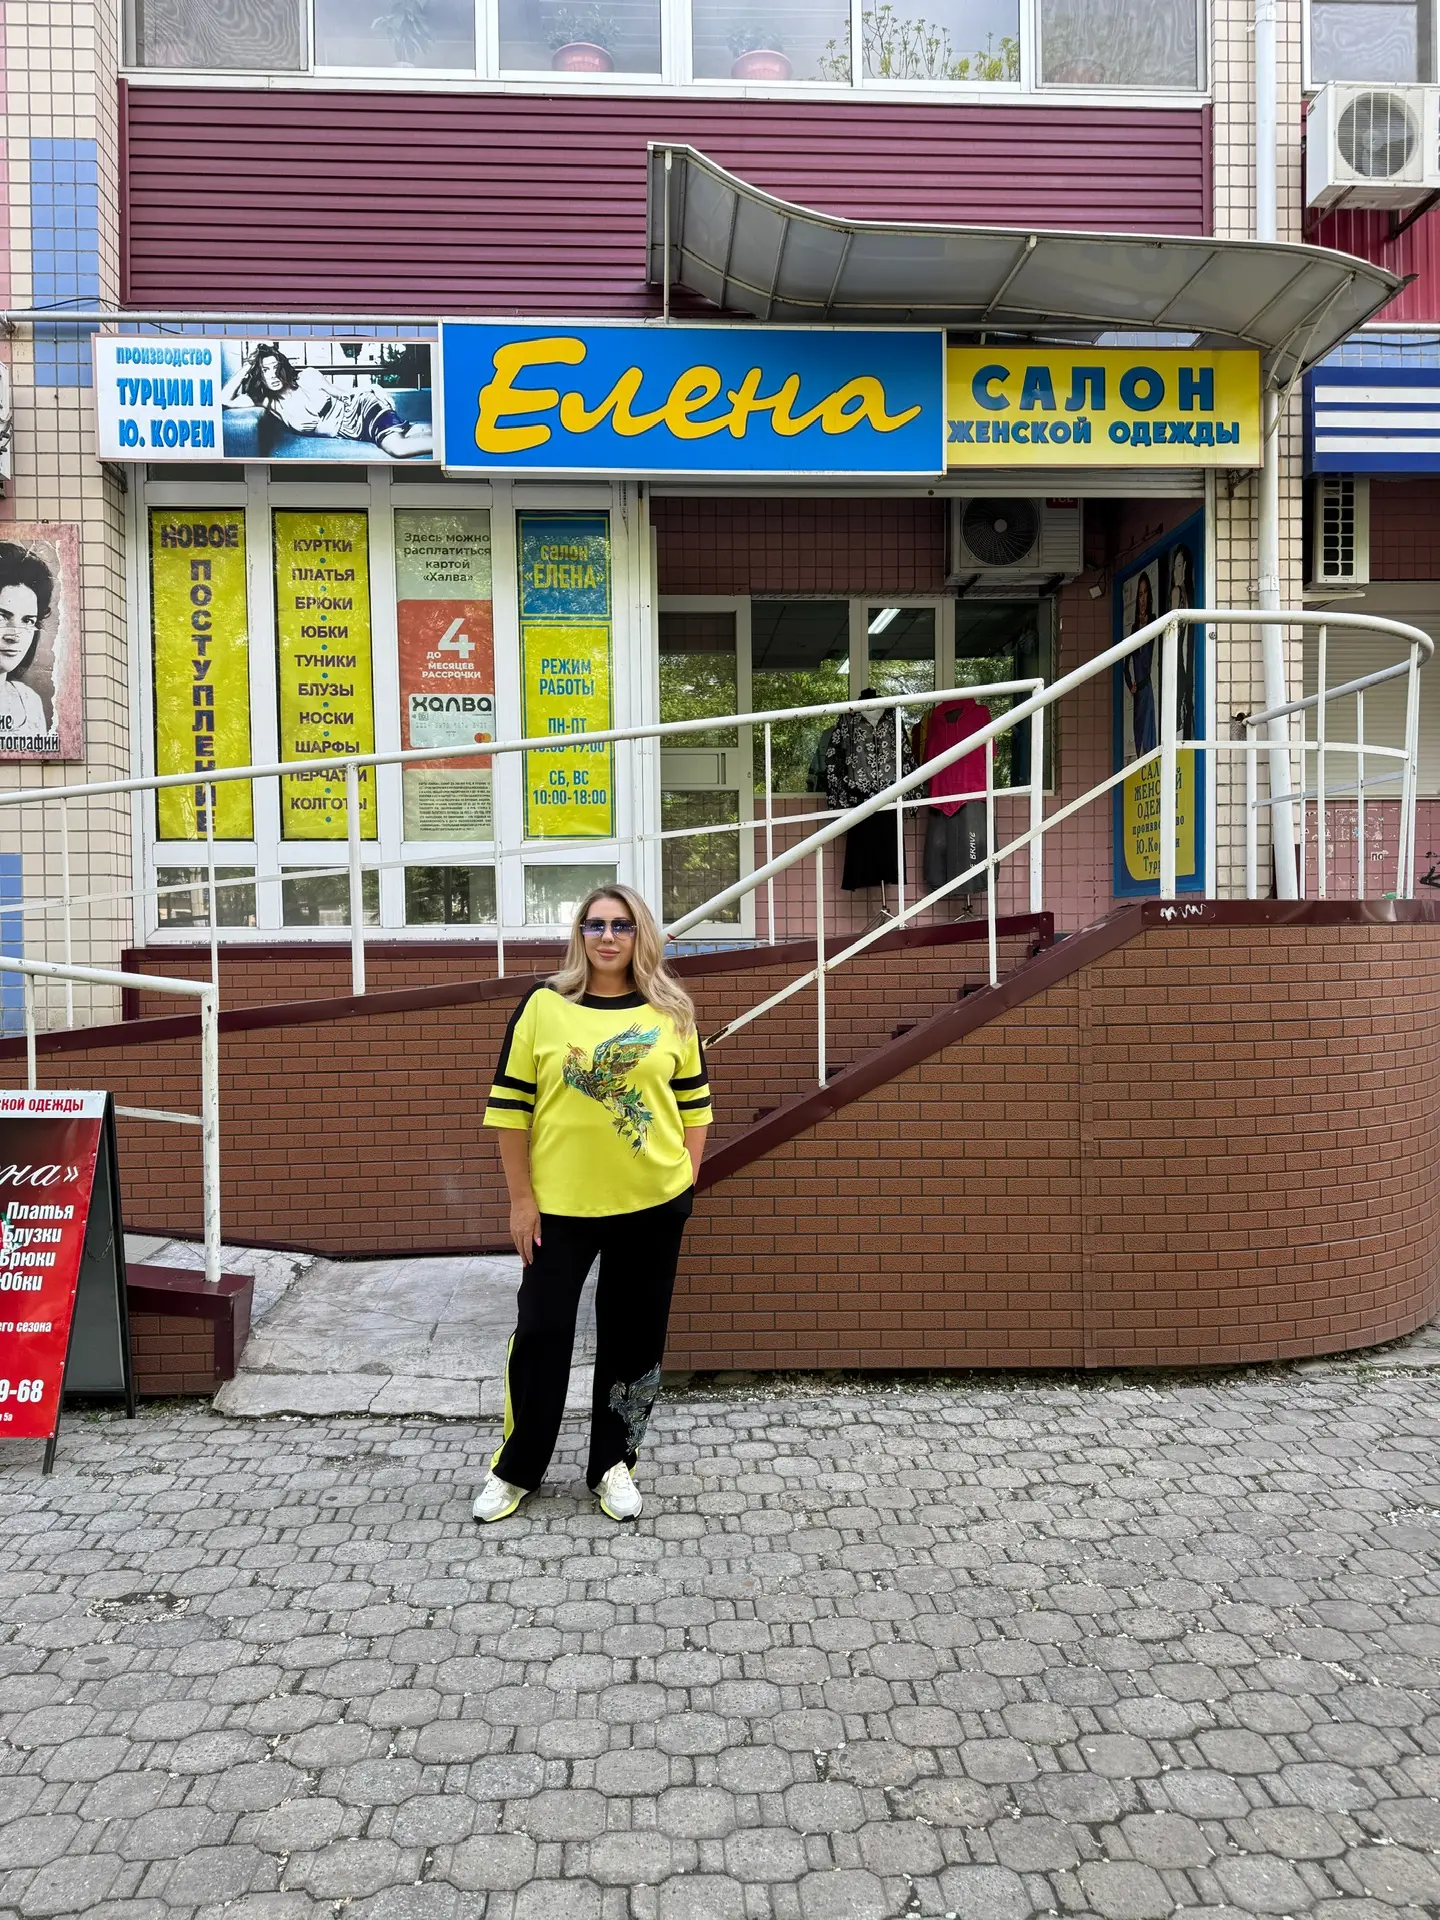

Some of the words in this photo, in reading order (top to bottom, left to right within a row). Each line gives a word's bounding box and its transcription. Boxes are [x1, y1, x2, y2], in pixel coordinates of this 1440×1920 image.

[116, 347, 212, 367] ПРОИЗВОДСТВО
[116, 377, 194, 410] ТУРЦИИ
[200, 378, 213, 406] И
[474, 336, 922, 454] Елена
[971, 364, 1214, 411] САЛОН
[118, 419, 146, 447] Ю.
[151, 419, 215, 448] КОРЕИ
[947, 417, 1091, 443] ЖЕНСКОЙ
[1108, 420, 1239, 447] ОДЕЖДЫ
[161, 523, 239, 548] НОВОЕ
[404, 533, 442, 543] Здесь
[446, 533, 490, 543] можно
[293, 539, 353, 553] КУРТКИ
[404, 547, 491, 557] расплатиться
[540, 545, 588, 561] салон
[425, 560, 470, 570] картой
[292, 568, 355, 581] ПЛАТЬЯ
[423, 572, 473, 582] «Халва»
[523, 564, 605, 589] «ЕЛЕНА»
[295, 596, 353, 610] БРЮКИ
[301, 625, 348, 638] ЮБКИ
[437, 617, 475, 659] 4
[294, 655, 356, 667] ТУНИКИ
[428, 662, 474, 671] МЕСЯЦЕВ
[541, 658, 592, 675] РЕЖИМ
[422, 671, 481, 679] РАССРОЧКИ
[298, 683, 354, 696] БЛУЗЫ
[539, 678, 594, 695] РАБОТЫ
[299, 711, 354, 724] НОСКИ
[548, 717, 587, 733] ПН-ПТ
[295, 740, 360, 753] ШАРФЫ
[289, 768, 367, 782] ПЕРЧАТИ
[549, 770, 569, 787] СБ,
[573, 770, 589, 785] ВС
[1141, 761, 1160, 781] САЛ
[1134, 767, 1182, 801] ЖЕНСЙ
[533, 789, 607, 805] 10:00-18:00
[0, 1097, 25, 1111] КОЙ
[28, 1098, 84, 1113] ОДЕЖДЫ
[7, 1201, 75, 1220] Платья
[3, 1225, 63, 1247] Блузки
[0, 1248, 56, 1270] Брюки
[16, 1321, 52, 1333] сезона
[0, 1379, 44, 1403] 9-68
